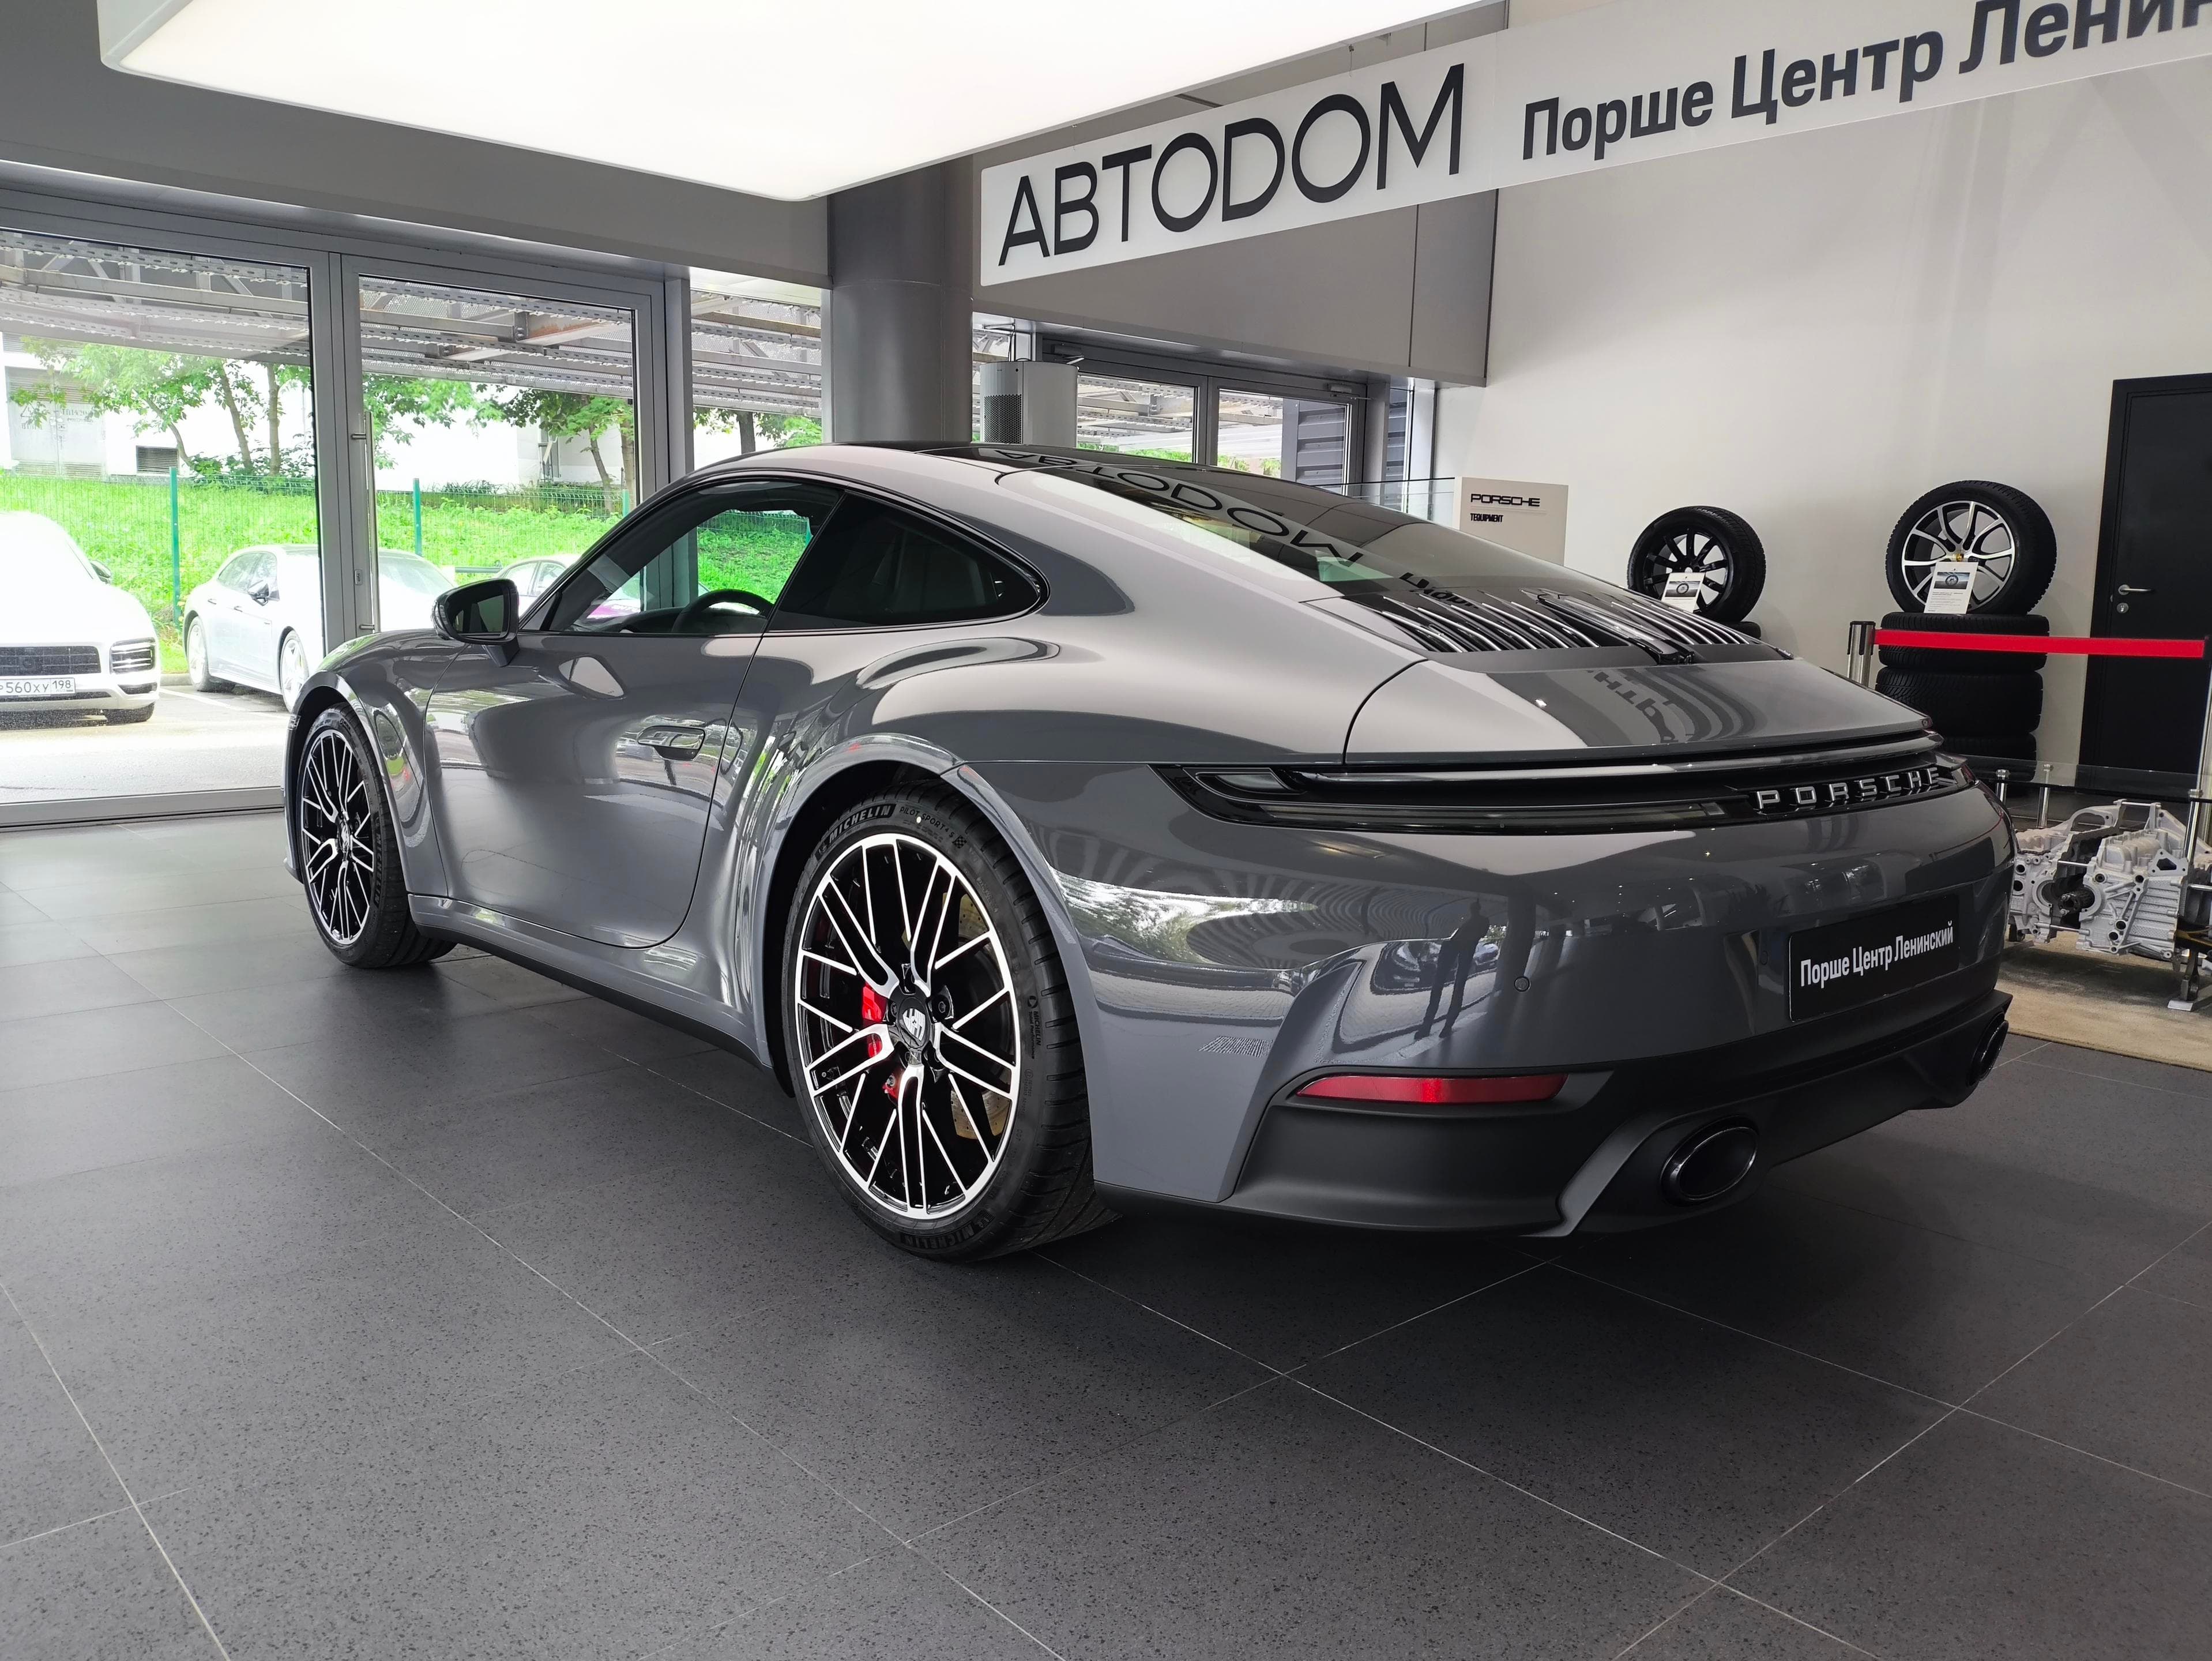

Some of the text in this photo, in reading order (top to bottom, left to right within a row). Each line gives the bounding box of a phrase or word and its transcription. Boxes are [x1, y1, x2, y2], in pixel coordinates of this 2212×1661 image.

[1522, 81, 1713, 161] Порше
[1731, 31, 1943, 125] Центр
[1470, 493, 1541, 508] PORSCHE
[1470, 513, 1504, 523] TEQUIPMENT
[52, 679, 72, 689] 198
[1756, 766, 1939, 810] PORSCHE
[829, 805, 892, 844] MICHELIN
[899, 806, 920, 817] PILOT
[921, 813, 947, 830] SPORT
[1800, 920, 1954, 989] Порше Центр Ленинский
[1033, 1010, 1041, 1046] MICHELIN
